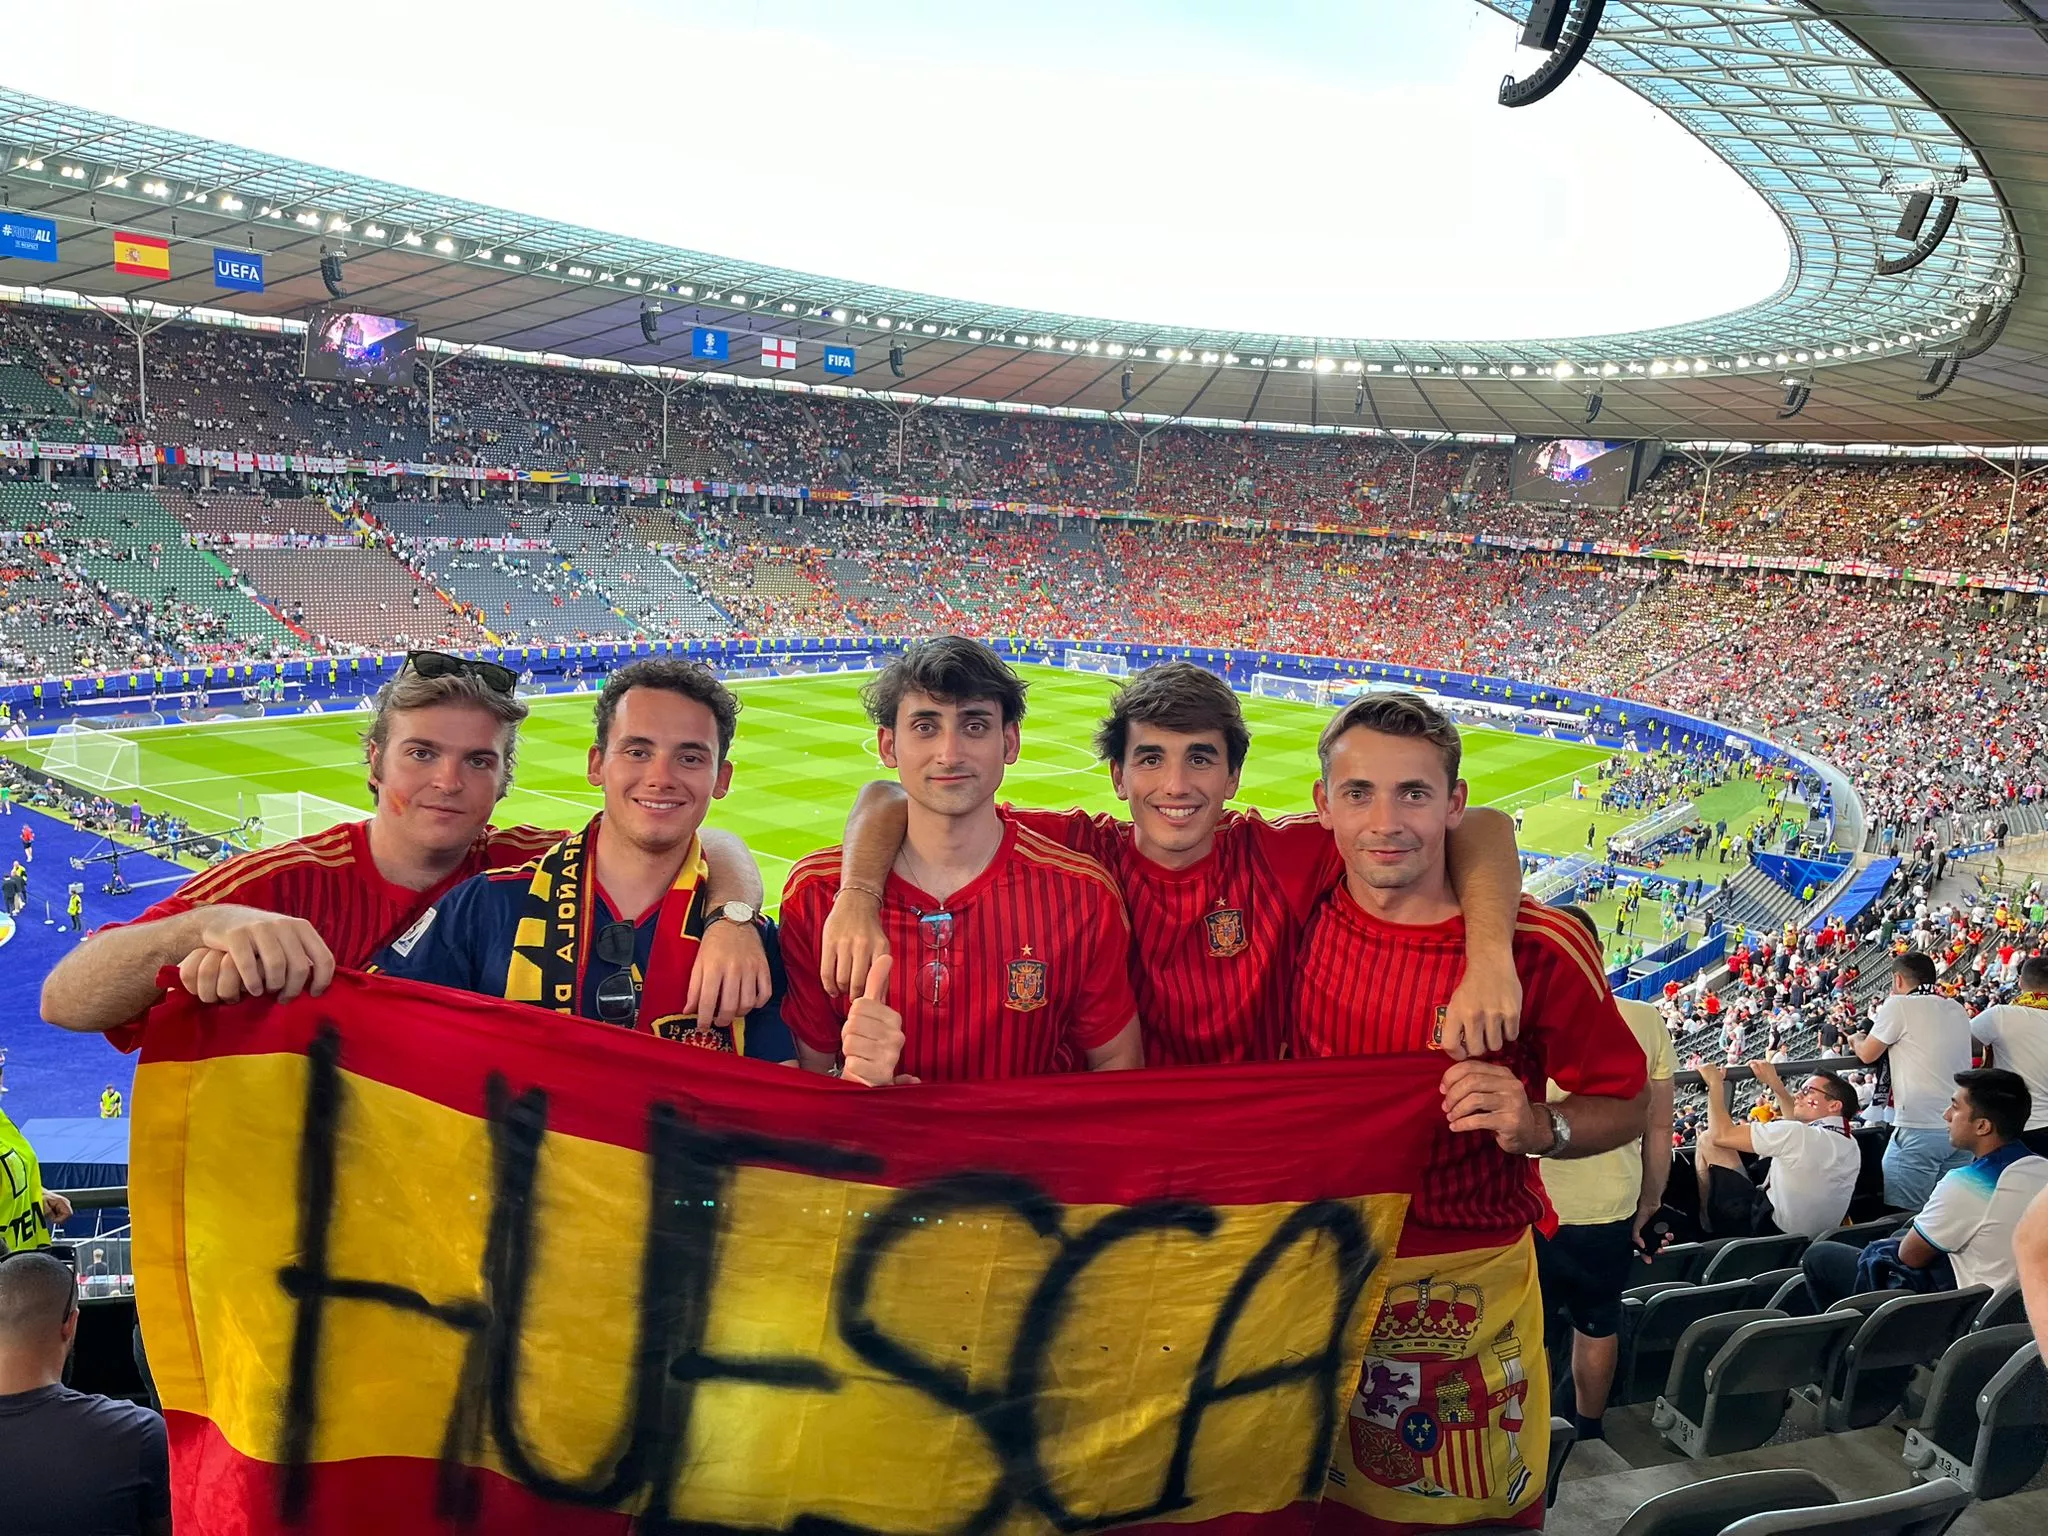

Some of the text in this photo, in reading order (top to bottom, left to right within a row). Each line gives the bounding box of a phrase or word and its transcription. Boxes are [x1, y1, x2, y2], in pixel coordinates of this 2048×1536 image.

[218, 261, 260, 281] UEFA
[828, 354, 852, 368] FIFA
[278, 1018, 1386, 1536] HUESCA
[1939, 1457, 1961, 1477] 13.1
